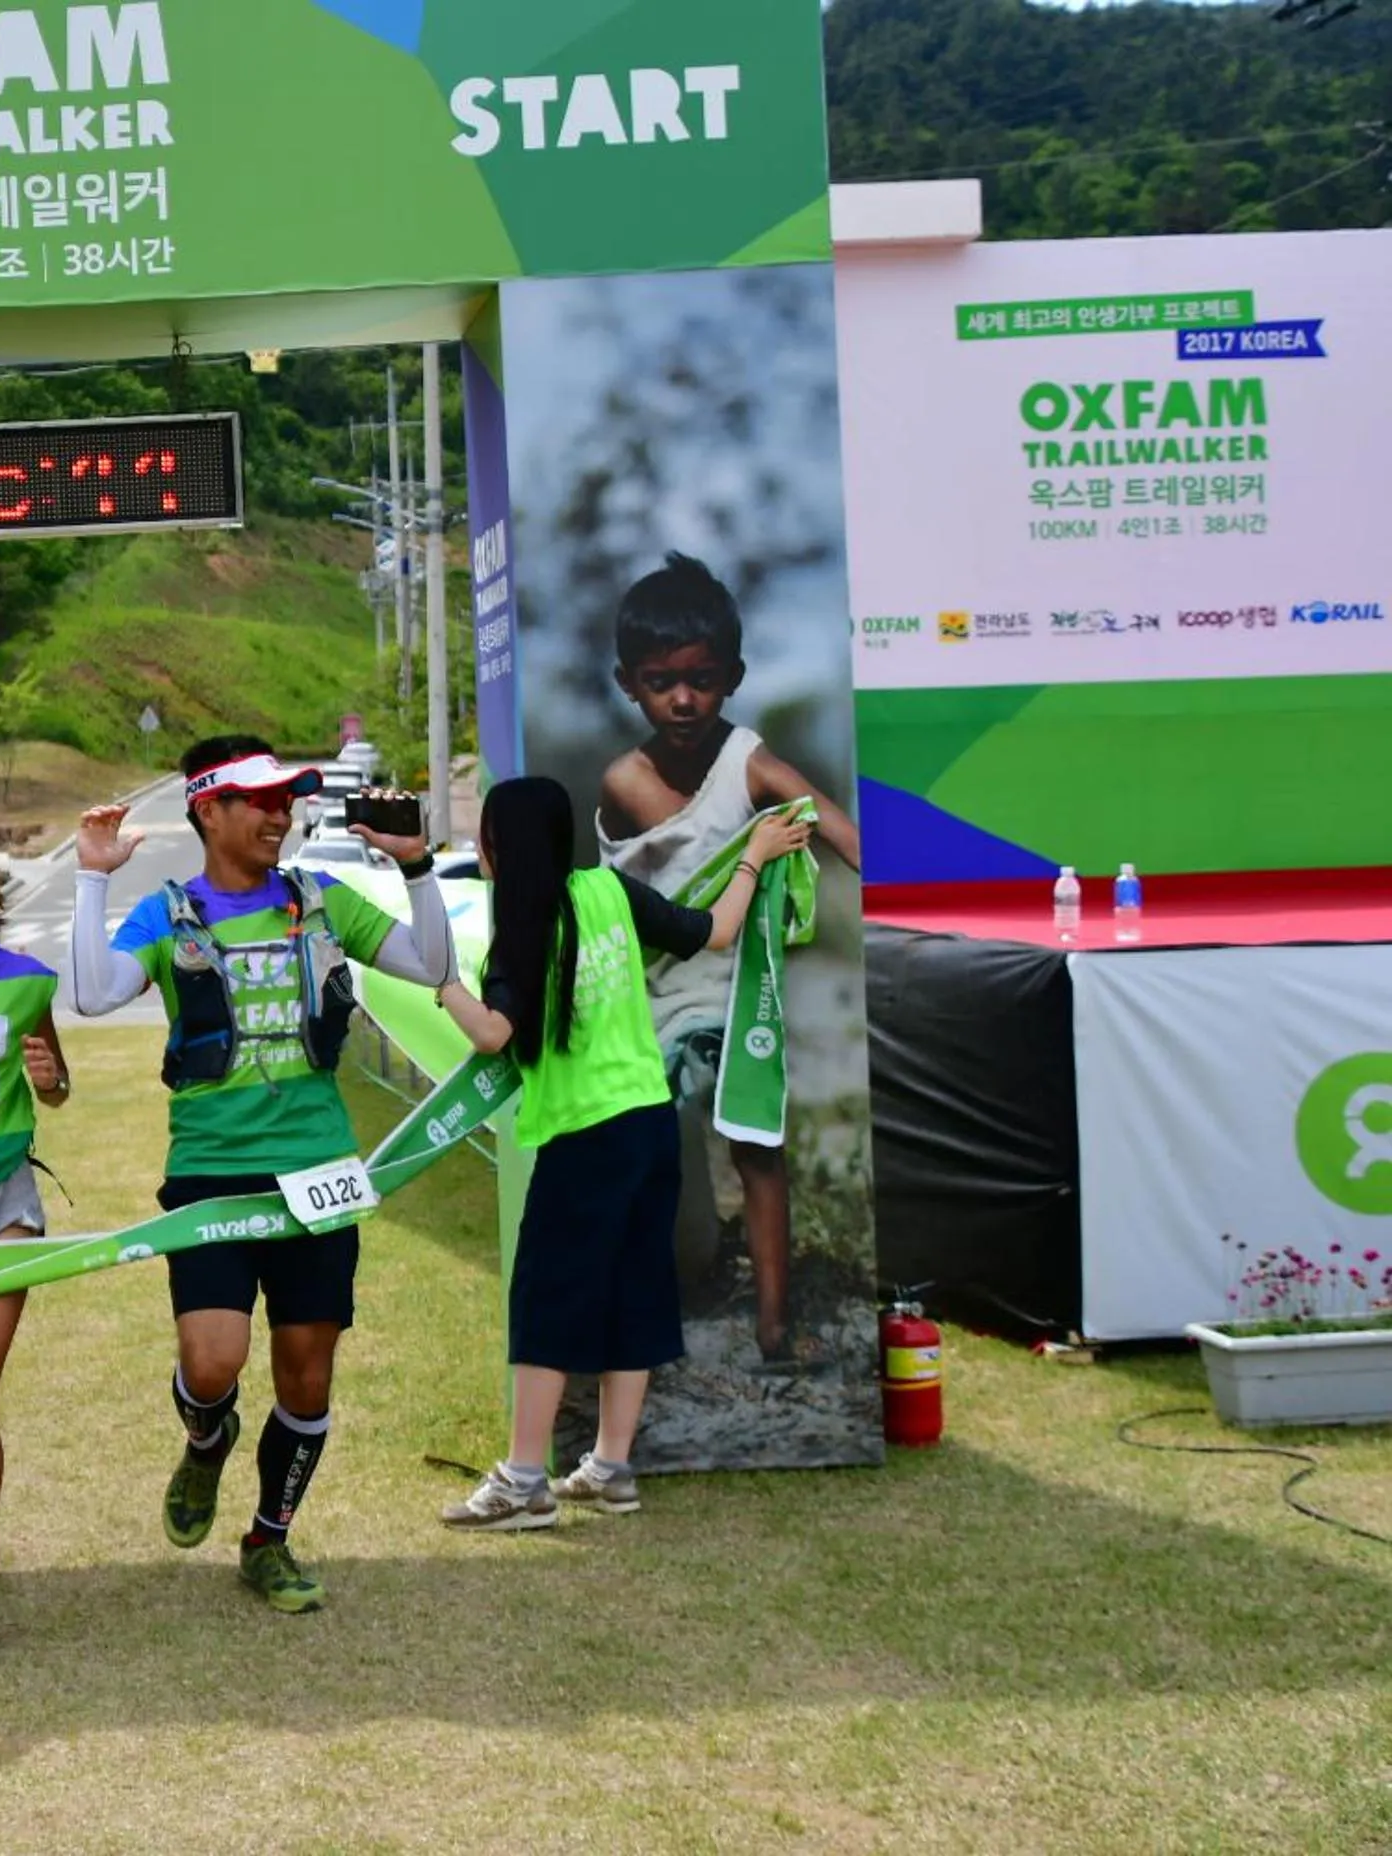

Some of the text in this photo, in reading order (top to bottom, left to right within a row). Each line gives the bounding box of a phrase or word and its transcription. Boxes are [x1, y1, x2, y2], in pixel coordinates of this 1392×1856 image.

[449, 64, 740, 157] START
[63, 236, 175, 276] 38시간
[967, 309, 1006, 333] 세계
[1012, 304, 1072, 330] 최고의
[1184, 329, 1308, 354] 2017 KOREA
[1019, 377, 1268, 432] OXFAM
[1022, 434, 1269, 469] TRAILWALKER
[1028, 473, 1266, 510] 옥스팜 트레일워커
[1028, 513, 1268, 540] 100KM 4인1조 38시간
[861, 616, 921, 634] OXFAM
[1290, 601, 1385, 624] KORAIL
[307, 1175, 363, 1211] 012C
[195, 1213, 286, 1242] KORAIL
